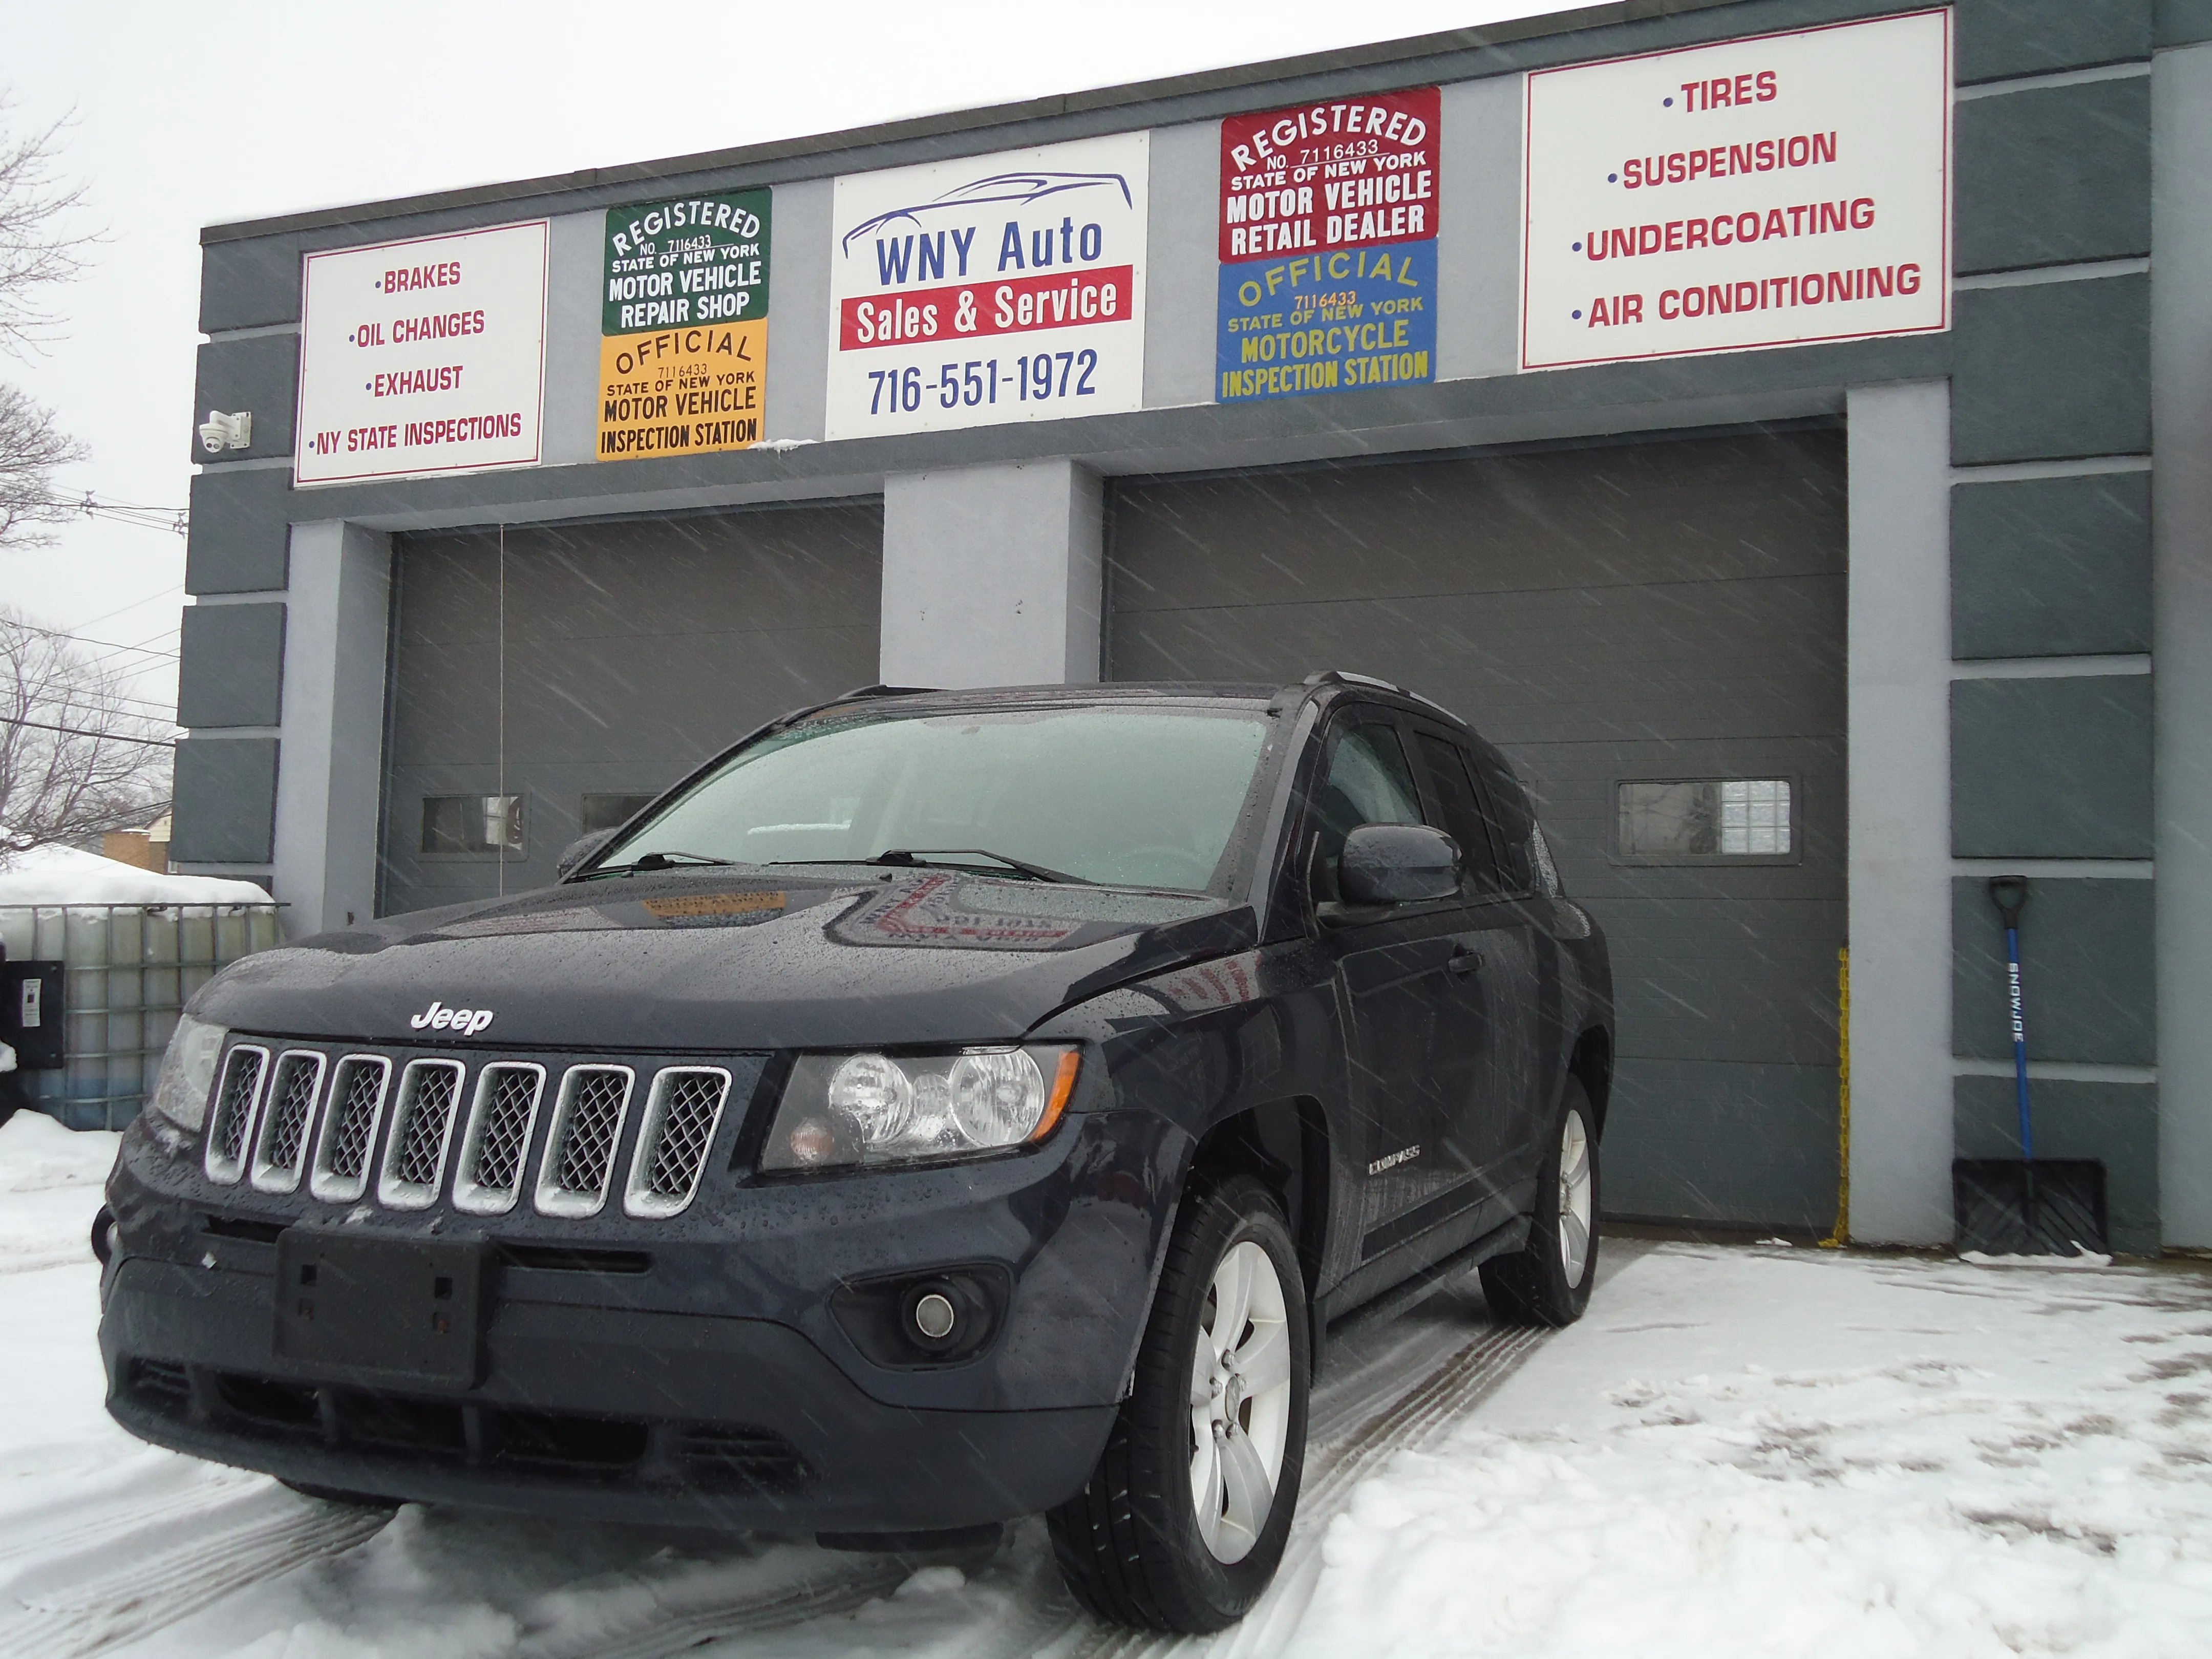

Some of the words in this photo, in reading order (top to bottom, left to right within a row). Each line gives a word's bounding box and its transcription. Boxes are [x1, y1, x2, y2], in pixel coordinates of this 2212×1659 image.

[1681, 71, 1777, 112] TIRES
[1231, 104, 1427, 173] REGISTERED
[1300, 139, 1378, 165] 7116433
[1231, 172, 1286, 191] STATE
[1293, 166, 1318, 182] OF
[1325, 159, 1366, 179] NEW
[1374, 151, 1427, 172] YORK
[1624, 132, 1837, 189] SUSPENSION
[1227, 188, 1313, 224] MOTOR
[1325, 170, 1432, 211] VEHICLE
[612, 200, 760, 256] REGISTERED
[668, 235, 712, 252] 7116433
[1231, 220, 1316, 256] RETAIL
[1327, 205, 1424, 243] DEALER
[1587, 197, 1875, 261] UNDERCOATING
[612, 257, 654, 272] STATE
[660, 253, 679, 267] OF
[684, 248, 715, 264] NEW
[720, 243, 759, 259] YORK
[876, 226, 976, 286] WNY
[997, 217, 1102, 271] Auto
[385, 262, 461, 294] BRAKES
[609, 272, 673, 301] MOTOR
[680, 261, 761, 293] VEHICLE
[1239, 251, 1419, 306] OFFICIAL
[1588, 293, 1643, 328] AIR
[1659, 263, 1921, 320] CONDITIONING
[621, 299, 689, 328] REPAIR
[697, 291, 750, 320] SHOP
[857, 299, 938, 343] Sales
[954, 290, 977, 332] &
[995, 278, 1116, 328] Service
[1228, 314, 1282, 332] STATE
[1291, 309, 1313, 326] OF
[1322, 305, 1364, 322] NEW
[1372, 297, 1423, 314] YORK
[1294, 291, 1356, 310] 7116433
[357, 323, 385, 347] OIL
[393, 310, 484, 342] CHANGES
[1242, 319, 1409, 364] MOTORCYCLE
[616, 330, 751, 374] OFFICIAL
[658, 364, 707, 378] 7116433
[374, 366, 463, 397] EXHAUST
[607, 382, 648, 396] STATE
[655, 378, 673, 392] OF
[679, 375, 710, 390] NEW
[717, 371, 755, 385] YORK
[868, 349, 1097, 415] 716-551-1972
[1223, 360, 1338, 397] INSPECTION
[1345, 351, 1428, 385] STATION
[604, 396, 668, 422] MOTOR
[675, 386, 756, 416] VEHICLE
[317, 431, 341, 455] NY
[348, 425, 397, 452] STATE
[405, 413, 521, 446] INSPECTIONS
[601, 424, 690, 453] INSPECTION
[695, 418, 757, 445] STATION
[411, 1002, 494, 1036] Jeep
